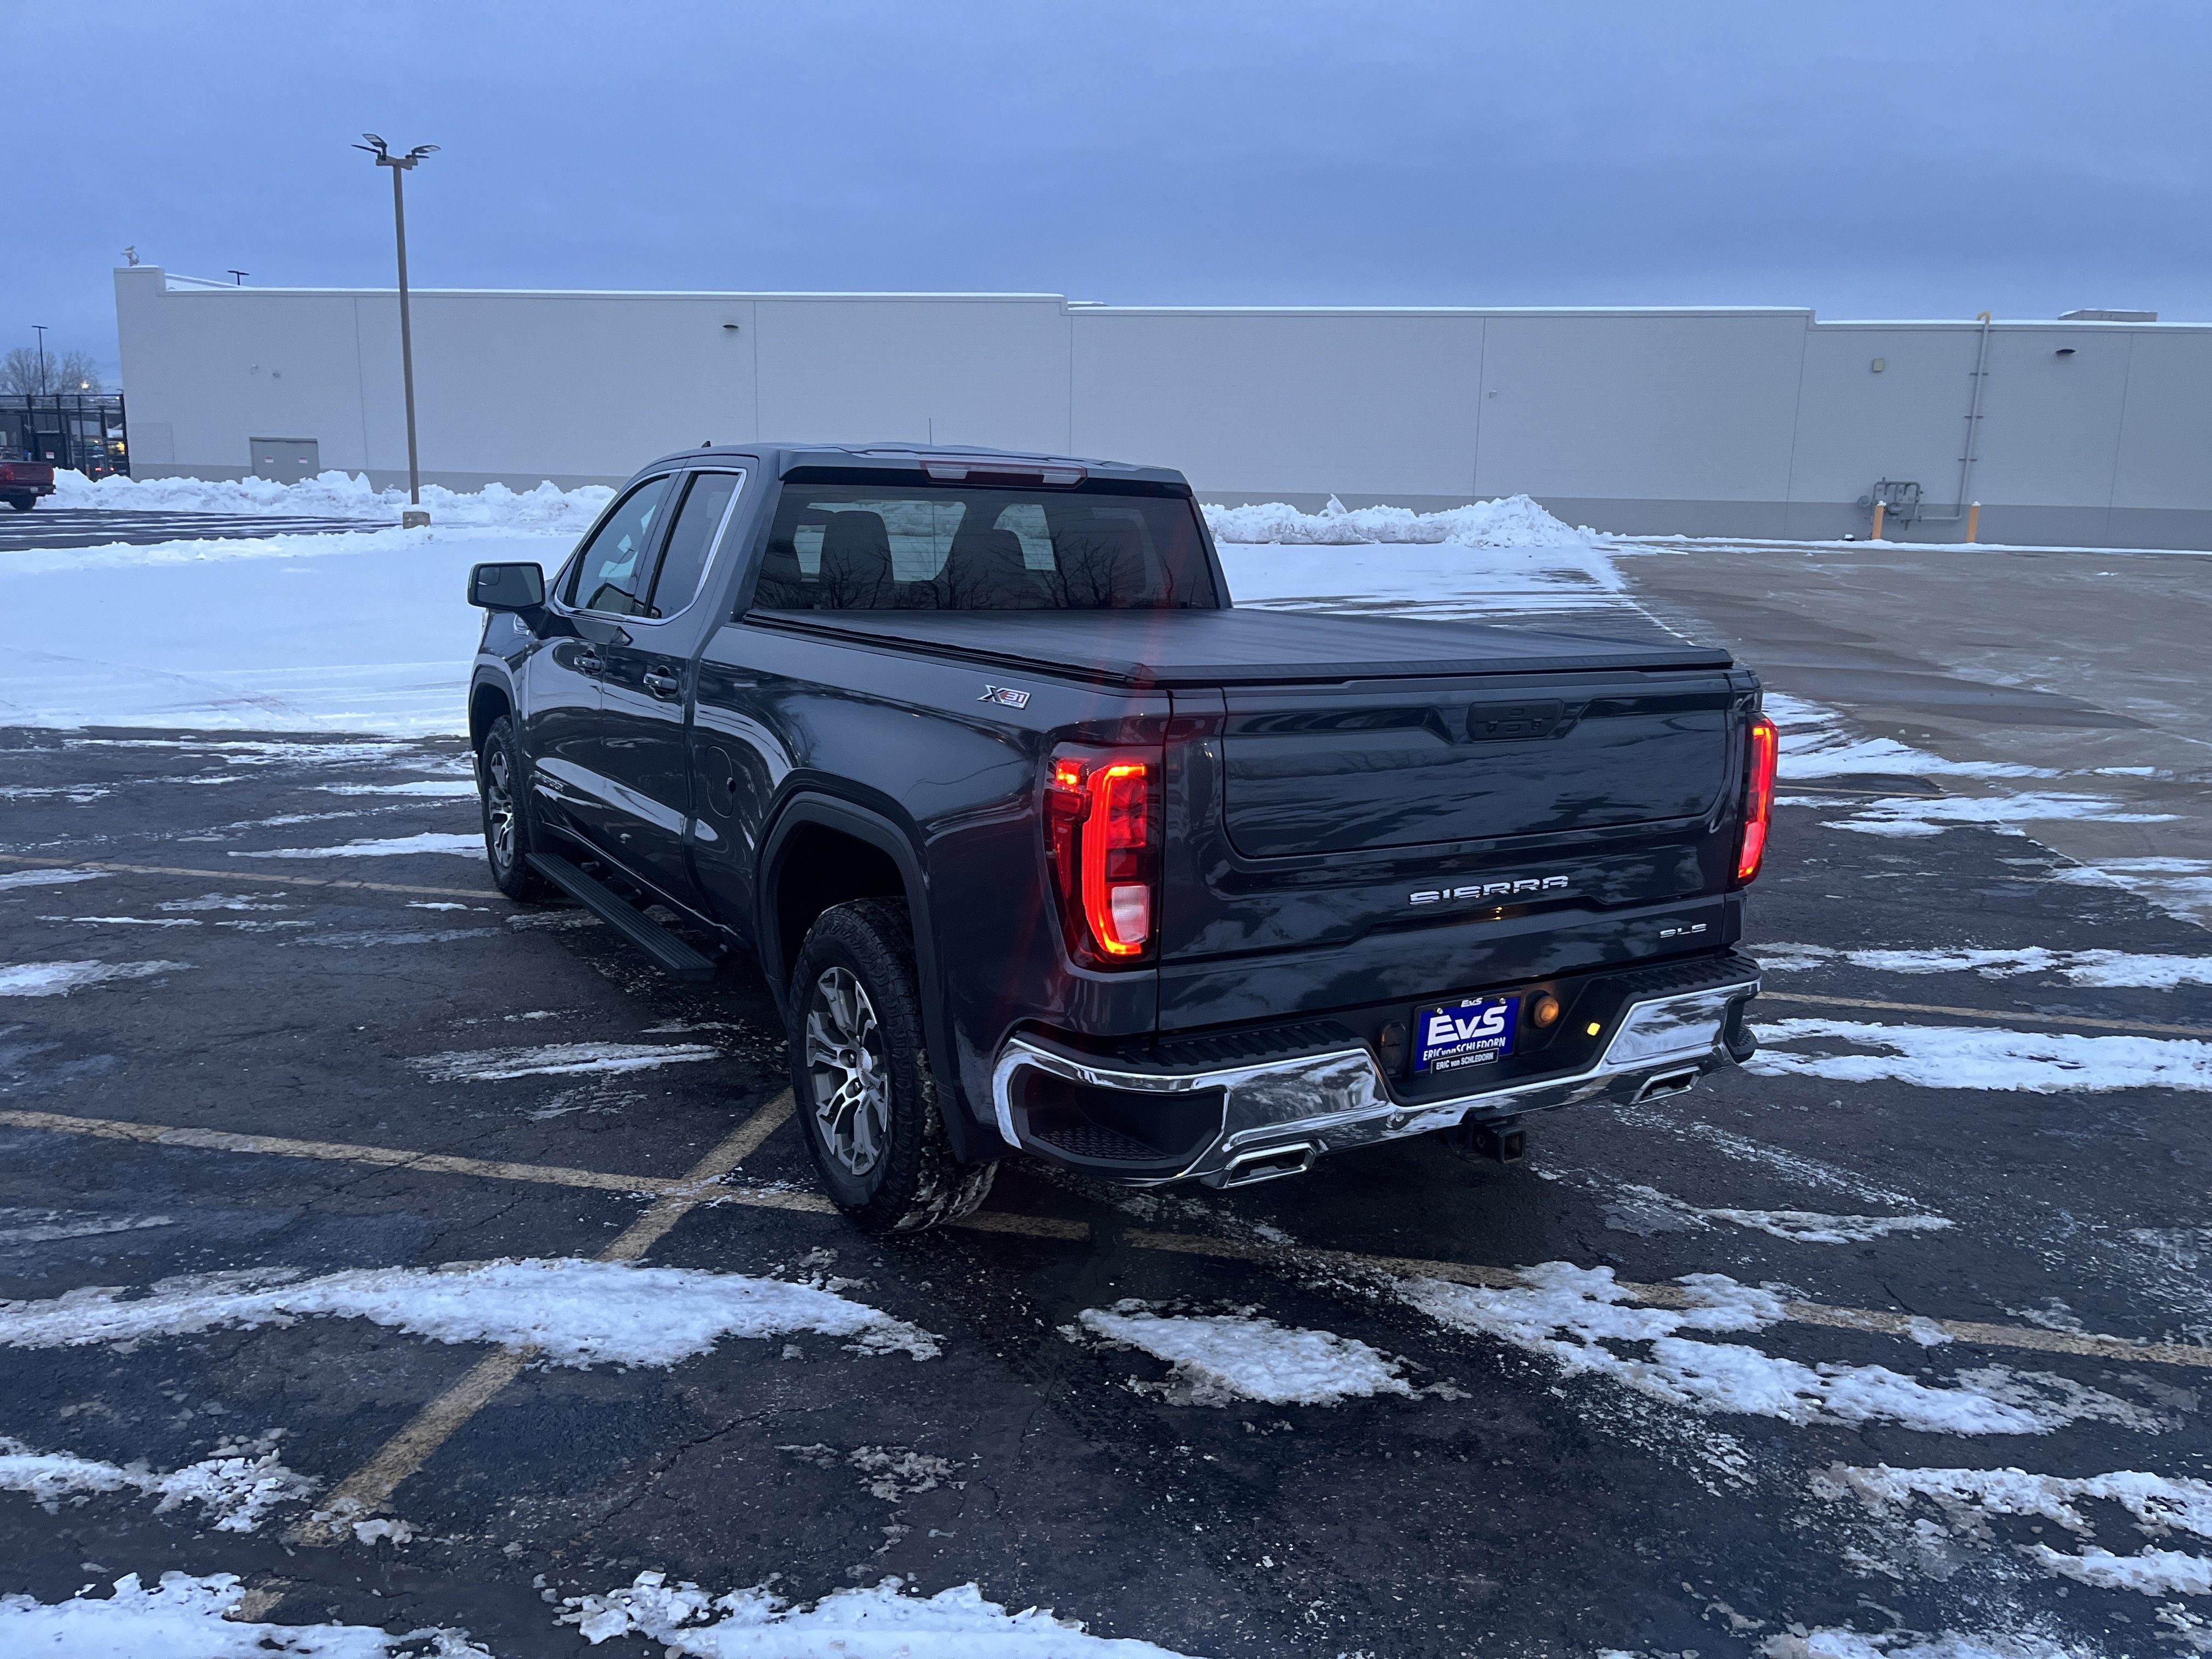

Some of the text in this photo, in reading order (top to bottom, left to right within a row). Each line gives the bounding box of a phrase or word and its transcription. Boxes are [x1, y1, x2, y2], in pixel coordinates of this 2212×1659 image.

[977, 685, 1031, 708] X31
[1409, 875, 1569, 905] SIERRA
[1660, 923, 1707, 938] SLE
[1423, 1048, 1442, 1061] ERIC
[1436, 1059, 1450, 1070] ERIC
[1461, 1052, 1494, 1065] SCHLEDORN
